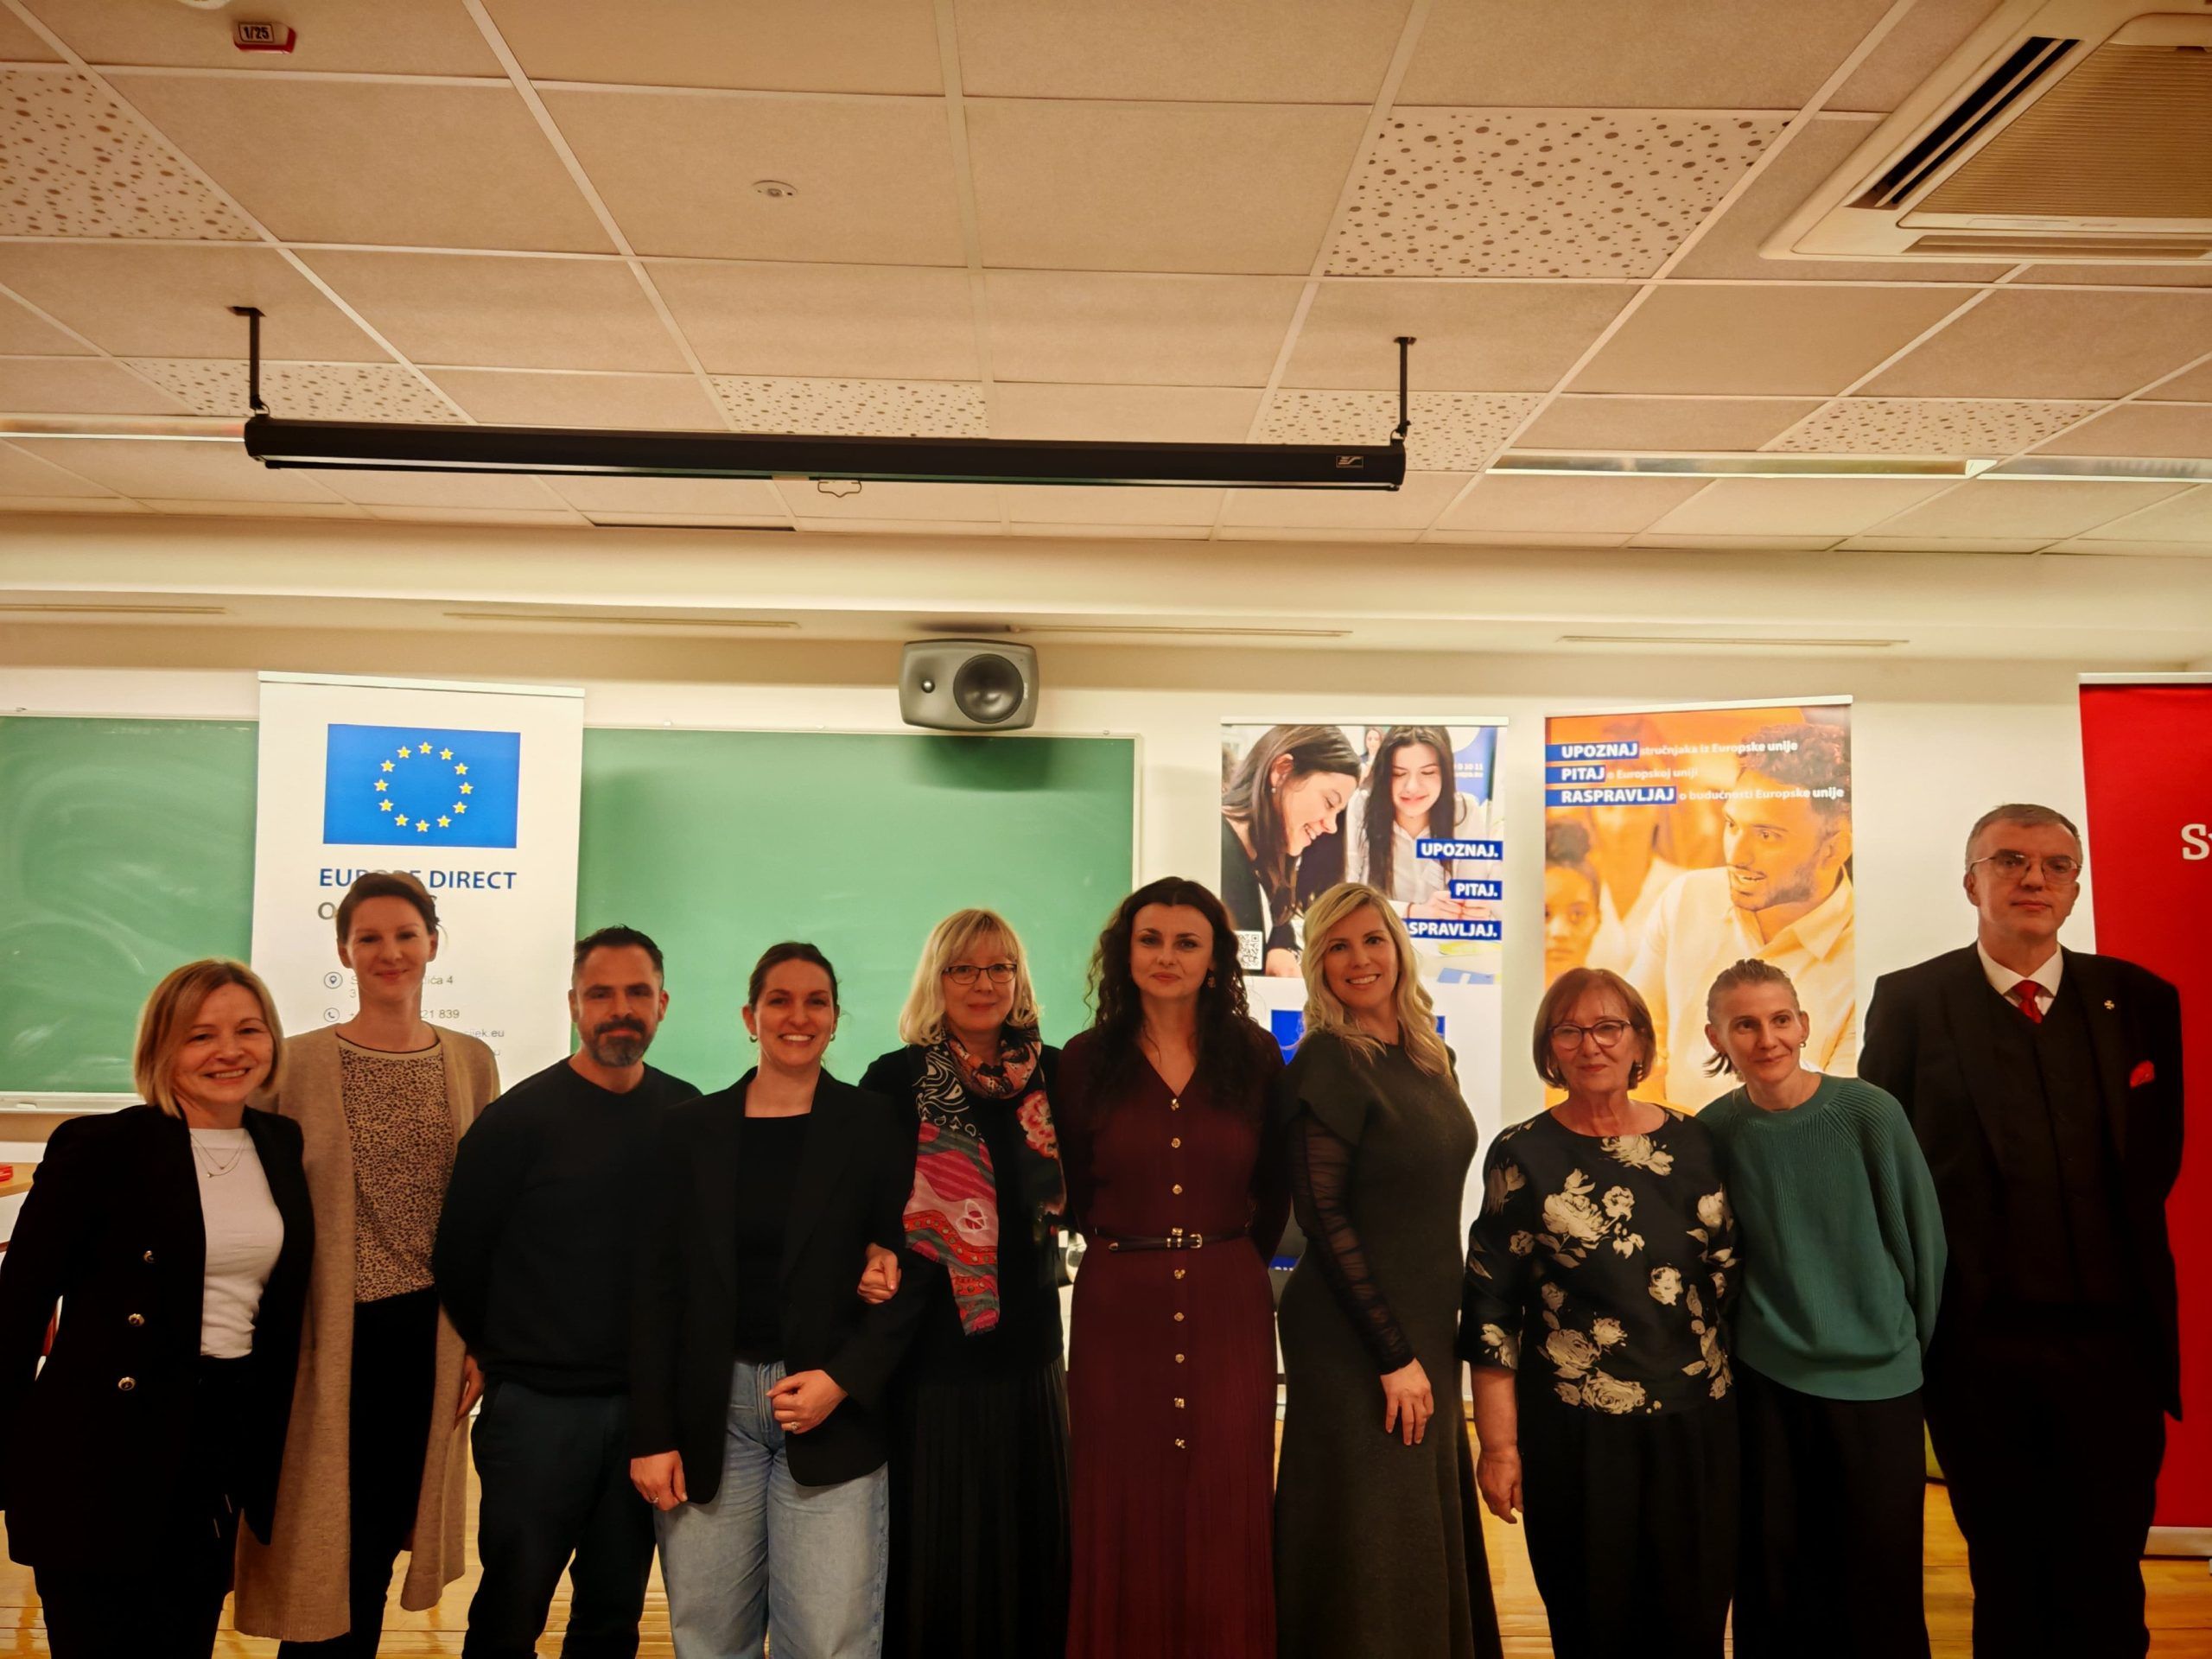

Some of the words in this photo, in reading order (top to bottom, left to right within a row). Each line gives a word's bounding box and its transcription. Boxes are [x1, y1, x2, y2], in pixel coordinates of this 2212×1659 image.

[243, 26, 270, 40] 1/25
[1560, 743, 1638, 759] UPOZNAJ
[1641, 744, 1699, 757] stručnjaka
[1700, 744, 1709, 753] iz
[1712, 741, 1765, 754] Europske
[1767, 741, 1798, 753] unije
[1560, 767, 1605, 781] PITAJ
[1617, 768, 1672, 781] Europskoj
[1673, 768, 1699, 779] uniji
[1560, 787, 1675, 804] RASPRAVLJAJ
[1679, 792, 1688, 801] o
[1689, 789, 1753, 801] budućnosti
[1755, 788, 1810, 800] Europske
[1812, 786, 1845, 800] unije
[1421, 842, 1499, 858] UPOZNAJ.
[2181, 823, 2212, 861] S
[429, 870, 518, 890] DIRECT
[1454, 882, 1498, 898] PITAJ.
[1408, 921, 1498, 938] SPRAVLJAJ.
[446, 975, 454, 985] 4
[421, 1009, 435, 1019] 21
[438, 1008, 461, 1019] 839
